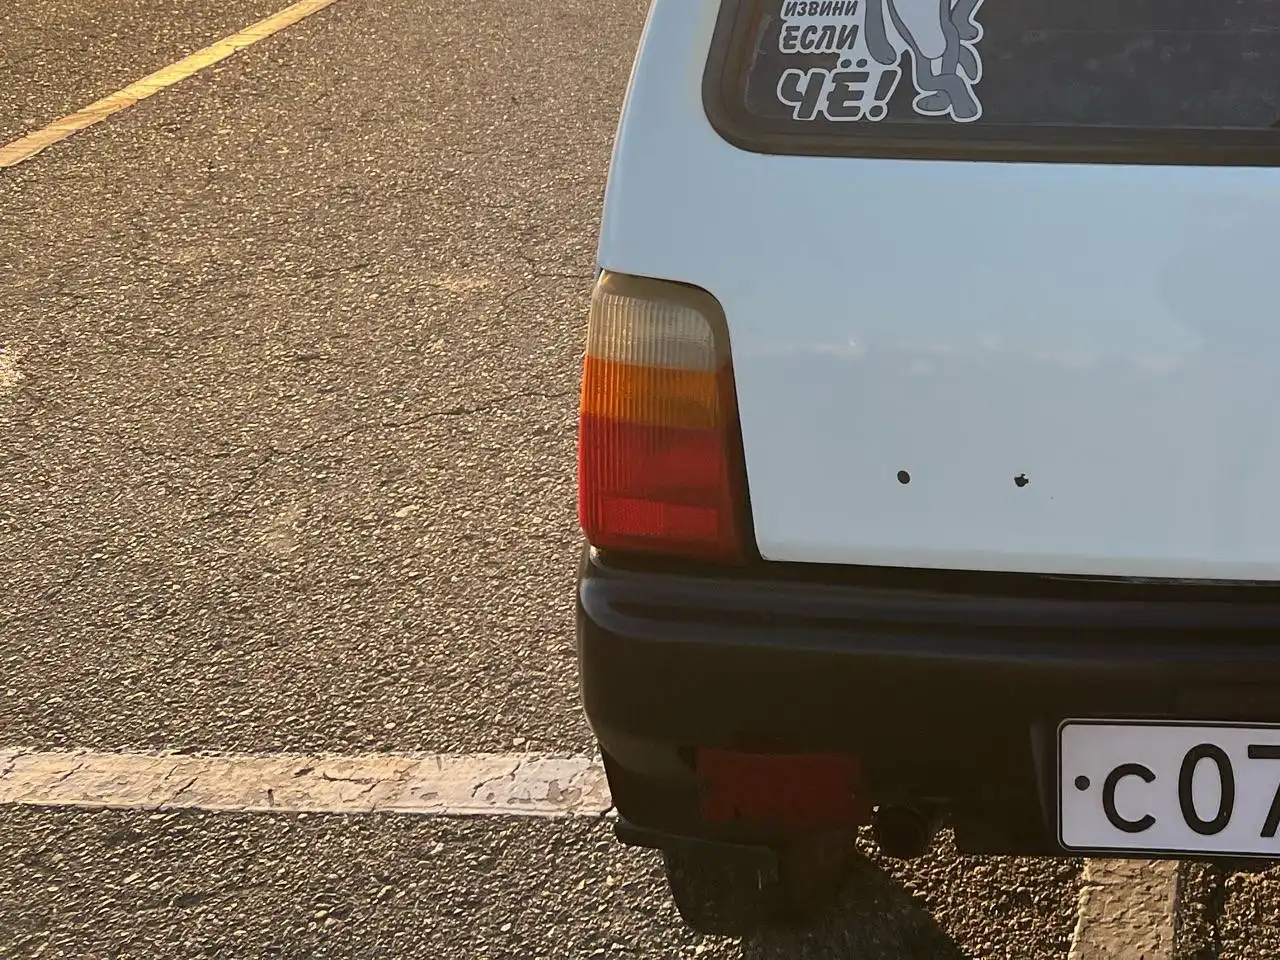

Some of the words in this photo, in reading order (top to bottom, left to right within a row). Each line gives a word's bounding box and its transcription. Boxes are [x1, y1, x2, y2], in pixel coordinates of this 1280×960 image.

[784, 0, 859, 17] ИЗВИНИ
[783, 24, 860, 50] ЕСЛИ
[780, 58, 898, 120] ЧЁ!
